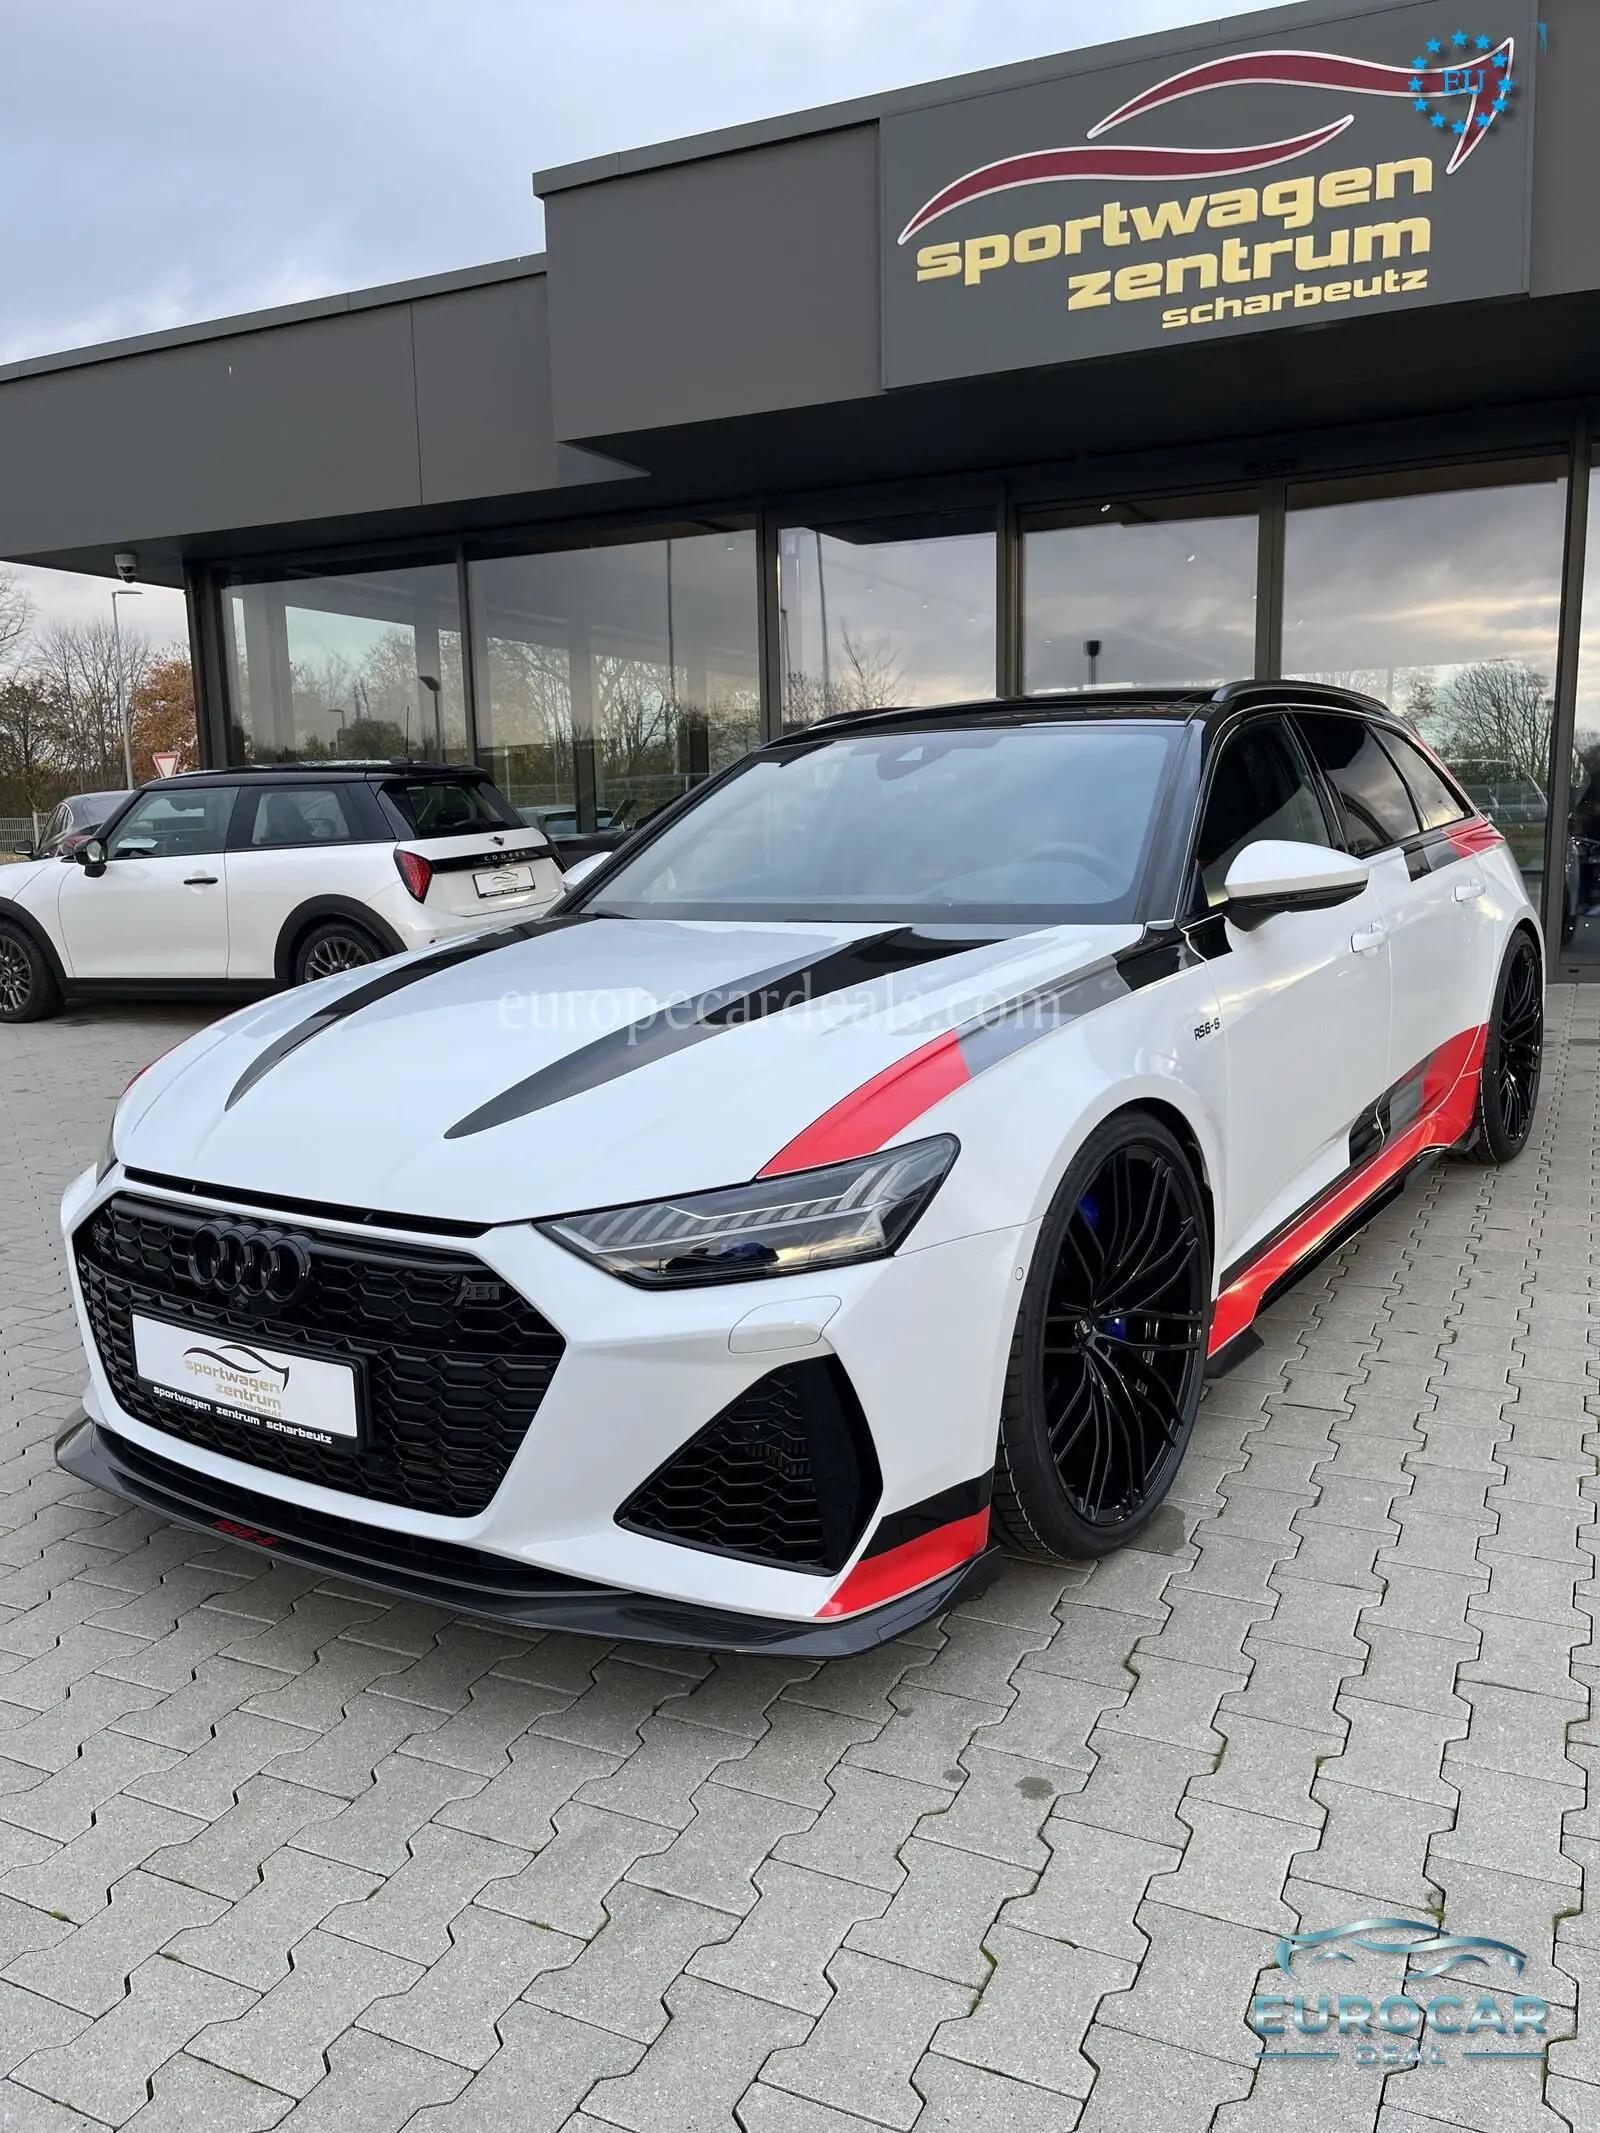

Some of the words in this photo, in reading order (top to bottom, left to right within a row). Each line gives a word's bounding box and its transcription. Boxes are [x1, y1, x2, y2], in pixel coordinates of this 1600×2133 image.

[917, 156, 1432, 286] sportwagen
[1067, 217, 1431, 311] zentrum
[1161, 268, 1428, 329] scharbeutz
[484, 850, 527, 861] COOPER
[1194, 1017, 1220, 1041] RS6-S
[184, 1358, 281, 1395] sportwagen
[214, 1382, 282, 1410] zentrum
[153, 1385, 211, 1412] sportwagen
[215, 1405, 260, 1426] zentrum
[265, 1419, 332, 1444] scharbeutz
